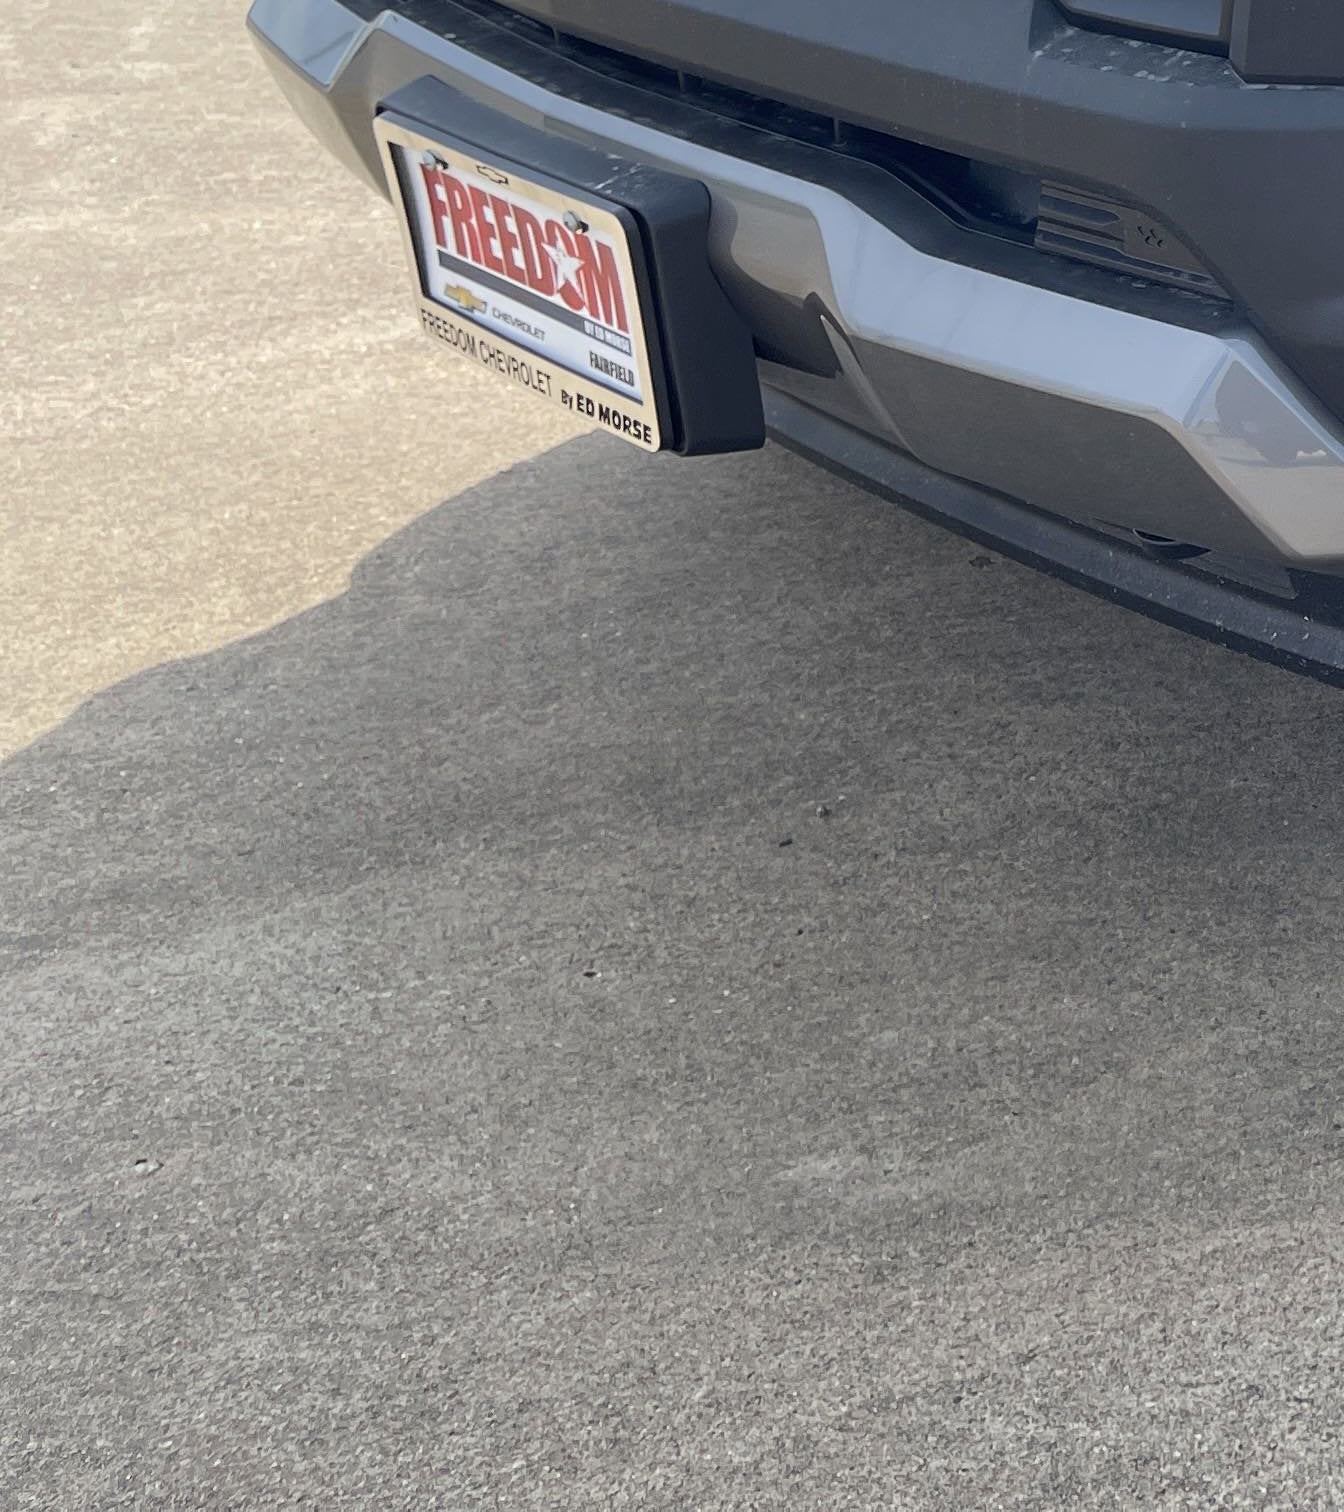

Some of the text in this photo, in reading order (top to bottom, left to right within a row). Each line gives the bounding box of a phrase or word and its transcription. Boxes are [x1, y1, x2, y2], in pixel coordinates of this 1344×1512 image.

[420, 163, 629, 334] FREEDOM
[492, 307, 545, 341] CHEVROLET
[420, 308, 477, 358] FREEDOM
[479, 340, 552, 397] CHEVROLET
[576, 393, 595, 418] ED
[598, 403, 652, 445] MORSE
[589, 350, 635, 387] FAIRFIELD
